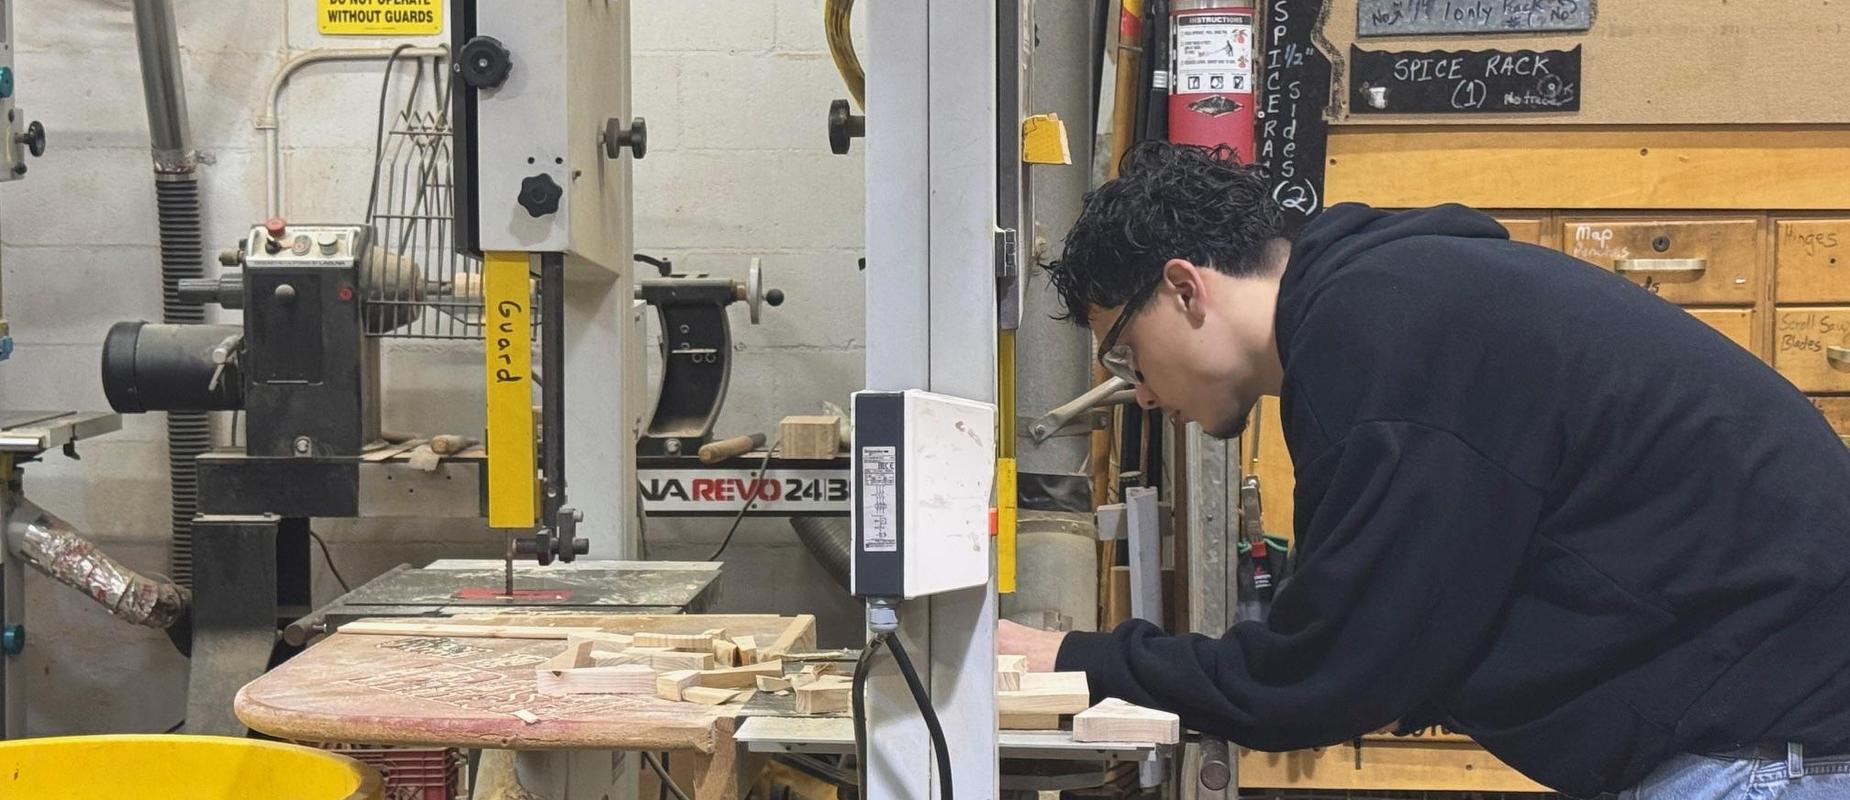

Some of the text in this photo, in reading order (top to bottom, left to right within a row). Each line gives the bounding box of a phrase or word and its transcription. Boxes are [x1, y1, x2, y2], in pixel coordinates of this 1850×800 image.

[328, 10, 434, 23] WITHOUT GUARDS
[1453, 0, 1493, 25] only
[1394, 55, 1550, 81] SPICE RACK
[1451, 79, 1487, 108] (1)
[1272, 178, 1318, 216] (2)
[1576, 225, 1613, 249] Map
[1784, 224, 1838, 257] Hinges
[1780, 314, 1815, 331] Scroll
[496, 301, 523, 383] Guard
[1780, 334, 1821, 352] Blades
[691, 478, 782, 502] REVO
